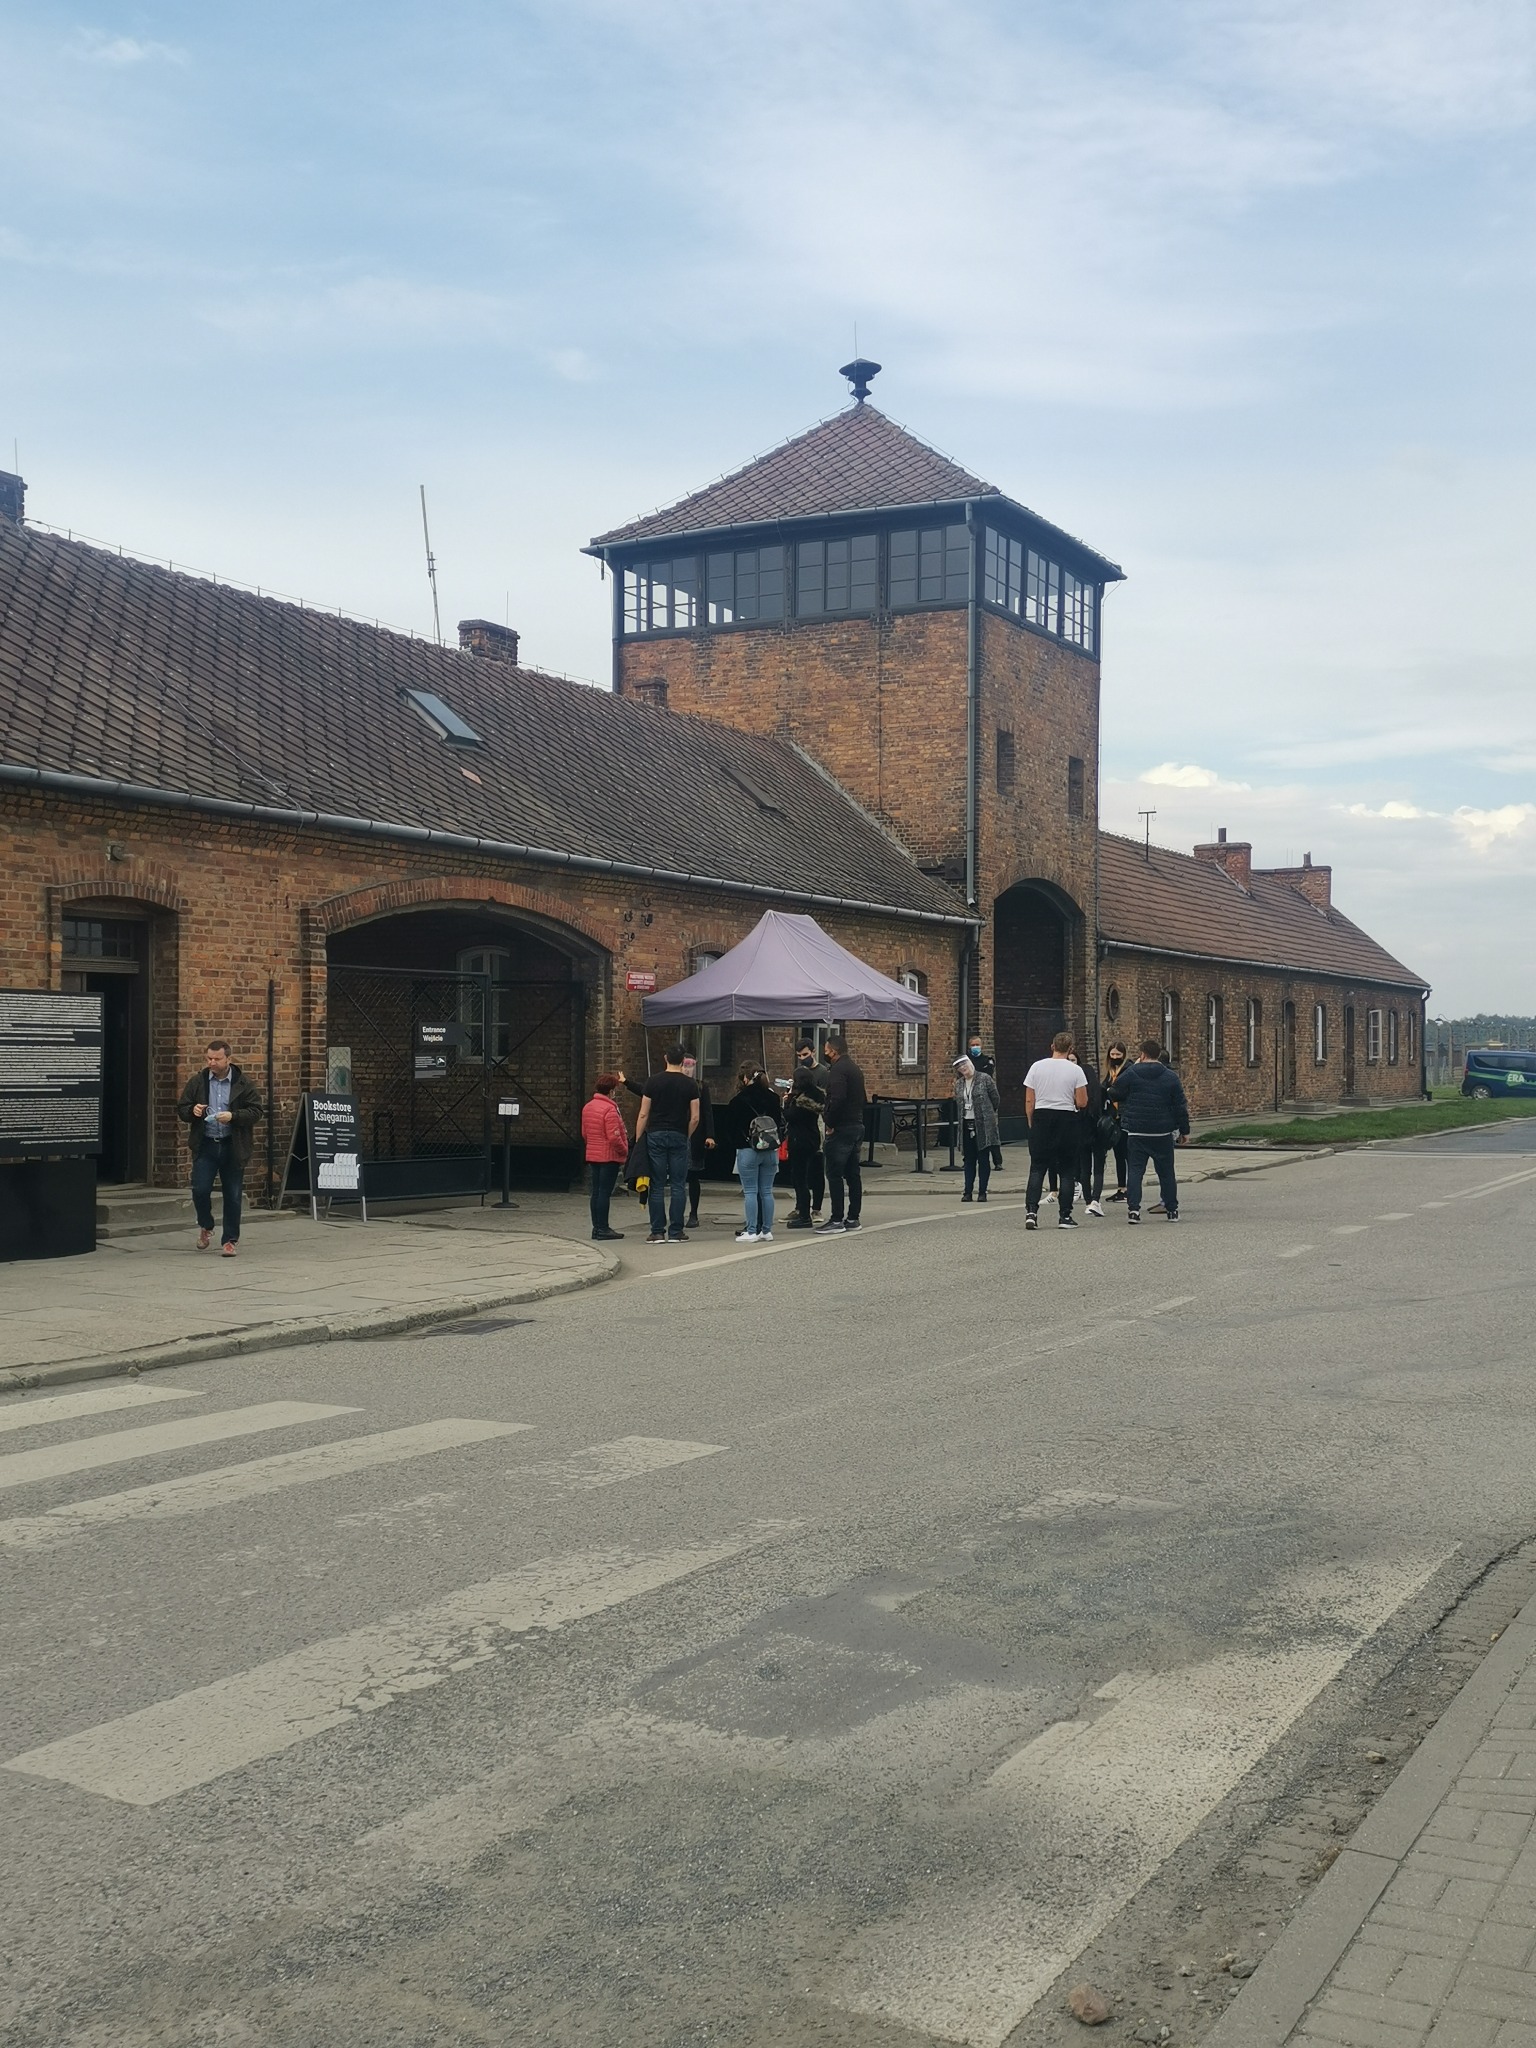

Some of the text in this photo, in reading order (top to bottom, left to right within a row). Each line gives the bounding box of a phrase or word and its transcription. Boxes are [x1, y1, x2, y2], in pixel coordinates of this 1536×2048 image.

[422, 1026, 446, 1034] Entrance
[313, 1100, 352, 1112] Bookstore
[313, 1110, 355, 1124] Księgarnia
